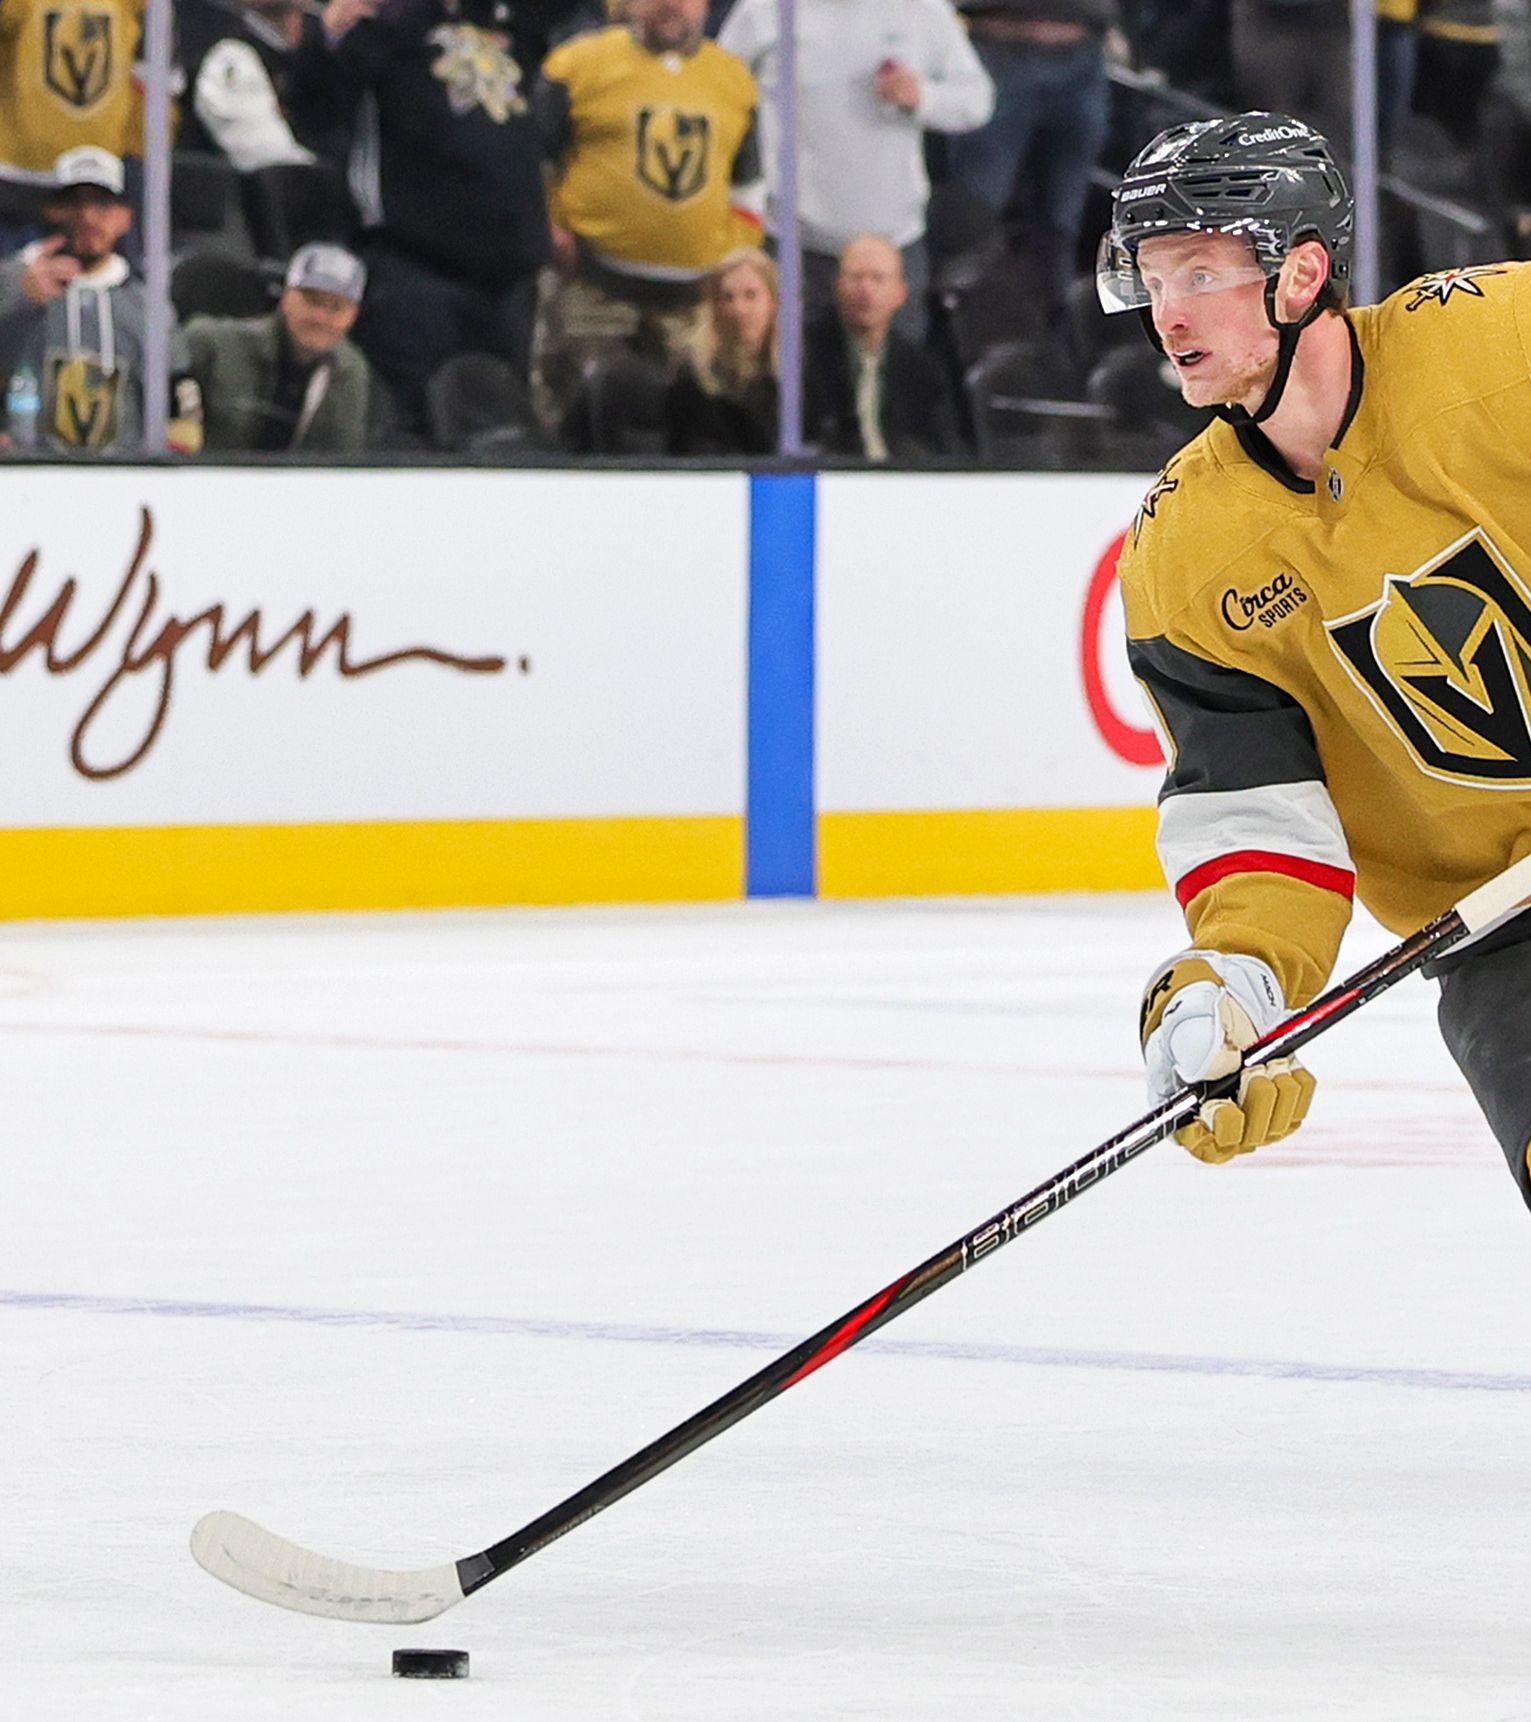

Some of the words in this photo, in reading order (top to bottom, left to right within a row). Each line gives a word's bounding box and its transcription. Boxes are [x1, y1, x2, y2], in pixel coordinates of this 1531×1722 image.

[1239, 126, 1310, 146] CreditOne
[1120, 183, 1166, 202] BAUER
[1221, 572, 1293, 630] Circa
[1258, 586, 1307, 629] SPORTS
